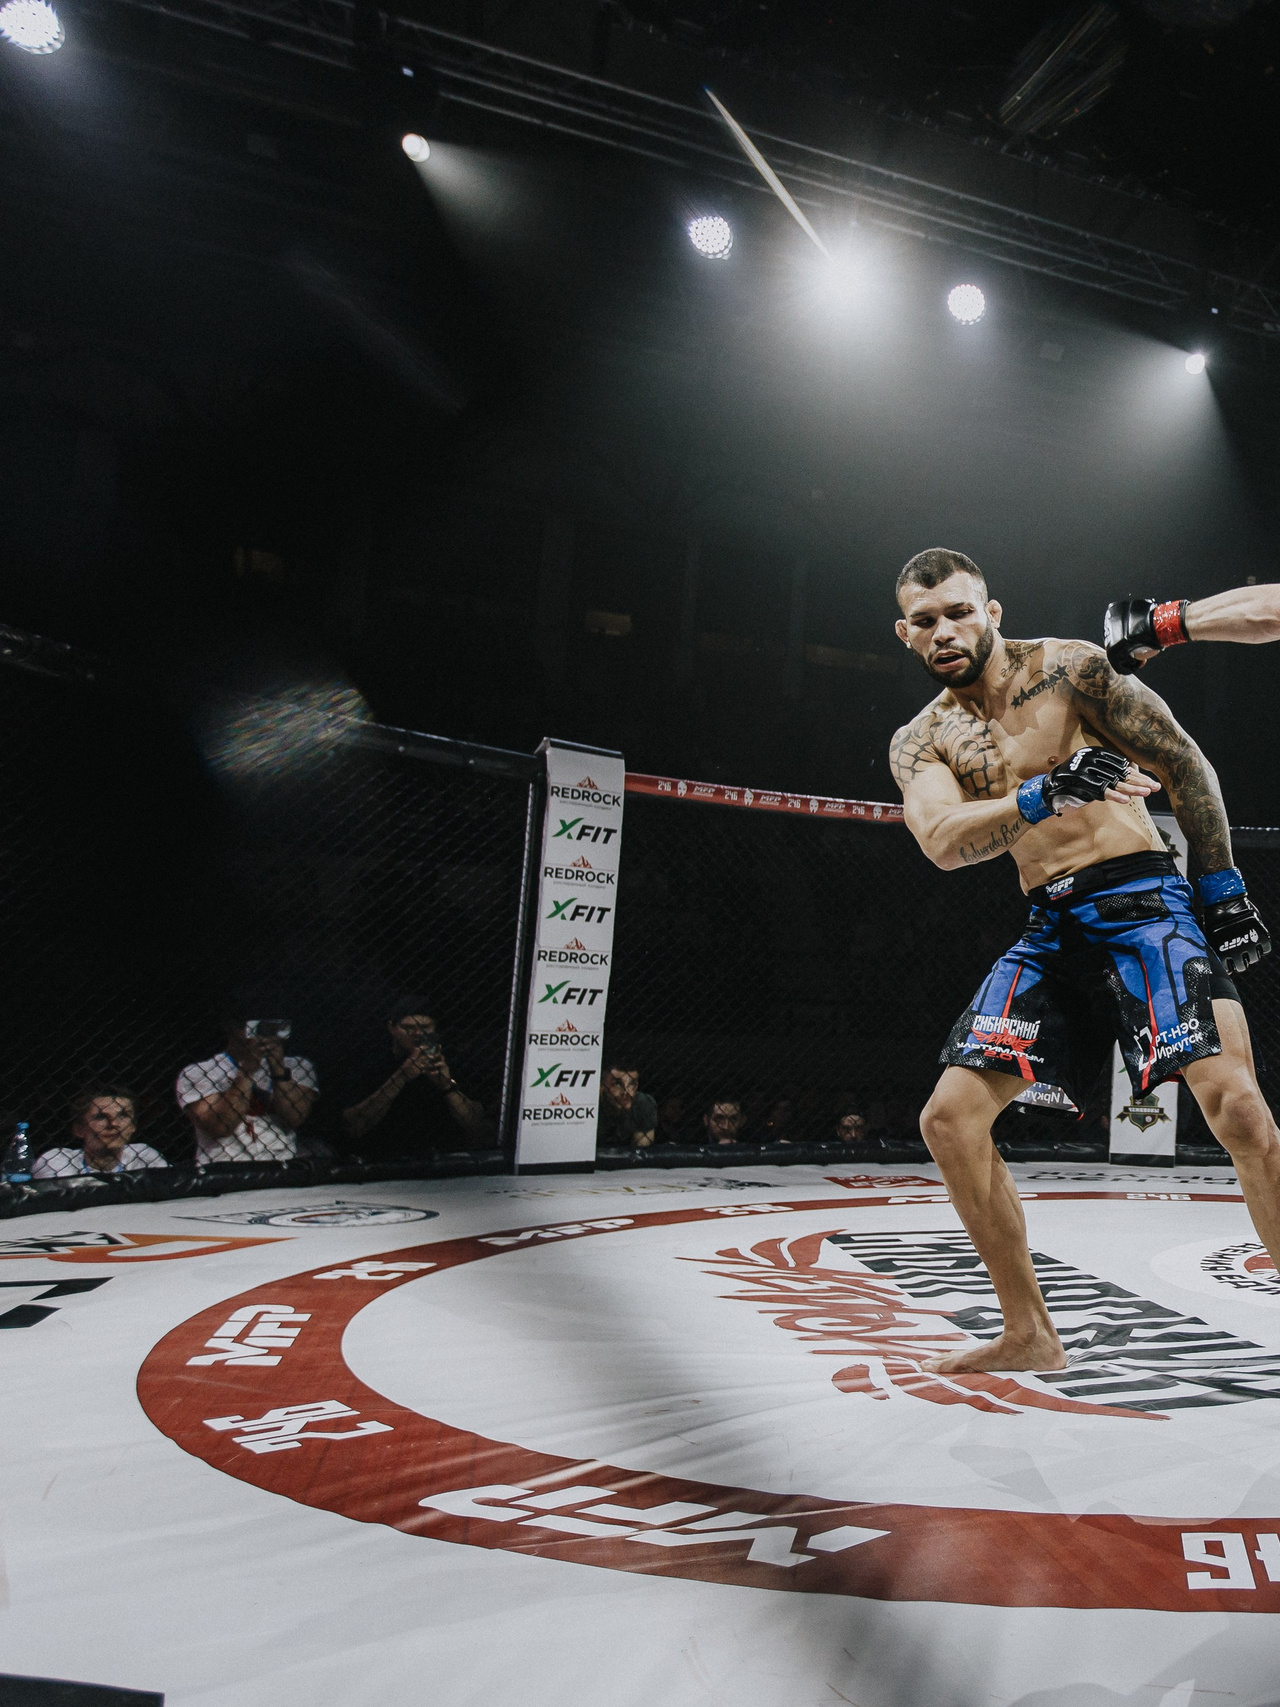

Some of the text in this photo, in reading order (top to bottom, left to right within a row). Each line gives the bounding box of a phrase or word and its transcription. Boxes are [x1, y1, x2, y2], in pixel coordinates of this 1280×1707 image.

[550, 785, 621, 807] REDROCK
[657, 780, 672, 792] 246
[724, 789, 738, 801] 246
[787, 798, 801, 809] 246
[852, 804, 866, 816] 246
[552, 817, 618, 845] XFIT
[543, 866, 615, 885] REDROCK
[545, 897, 612, 924] XFIT
[537, 949, 609, 966] REDROCK
[537, 980, 604, 1006] XFIT
[528, 1033, 600, 1046] REDROCK
[972, 1015, 1041, 1040] СИБИРСКИЙ
[956, 1041, 1045, 1064] УЛЬТИМАТУМ
[983, 1049, 1013, 1061] 2.0
[1157, 1031, 1204, 1060] Иркутск
[530, 1062, 596, 1088] XFIT
[522, 1107, 595, 1121] REDROCK
[1126, 1193, 1192, 1201] 246
[477, 1217, 635, 1246] MFP
[185, 1303, 312, 1366] MFP
[418, 1484, 892, 1568] MFP
